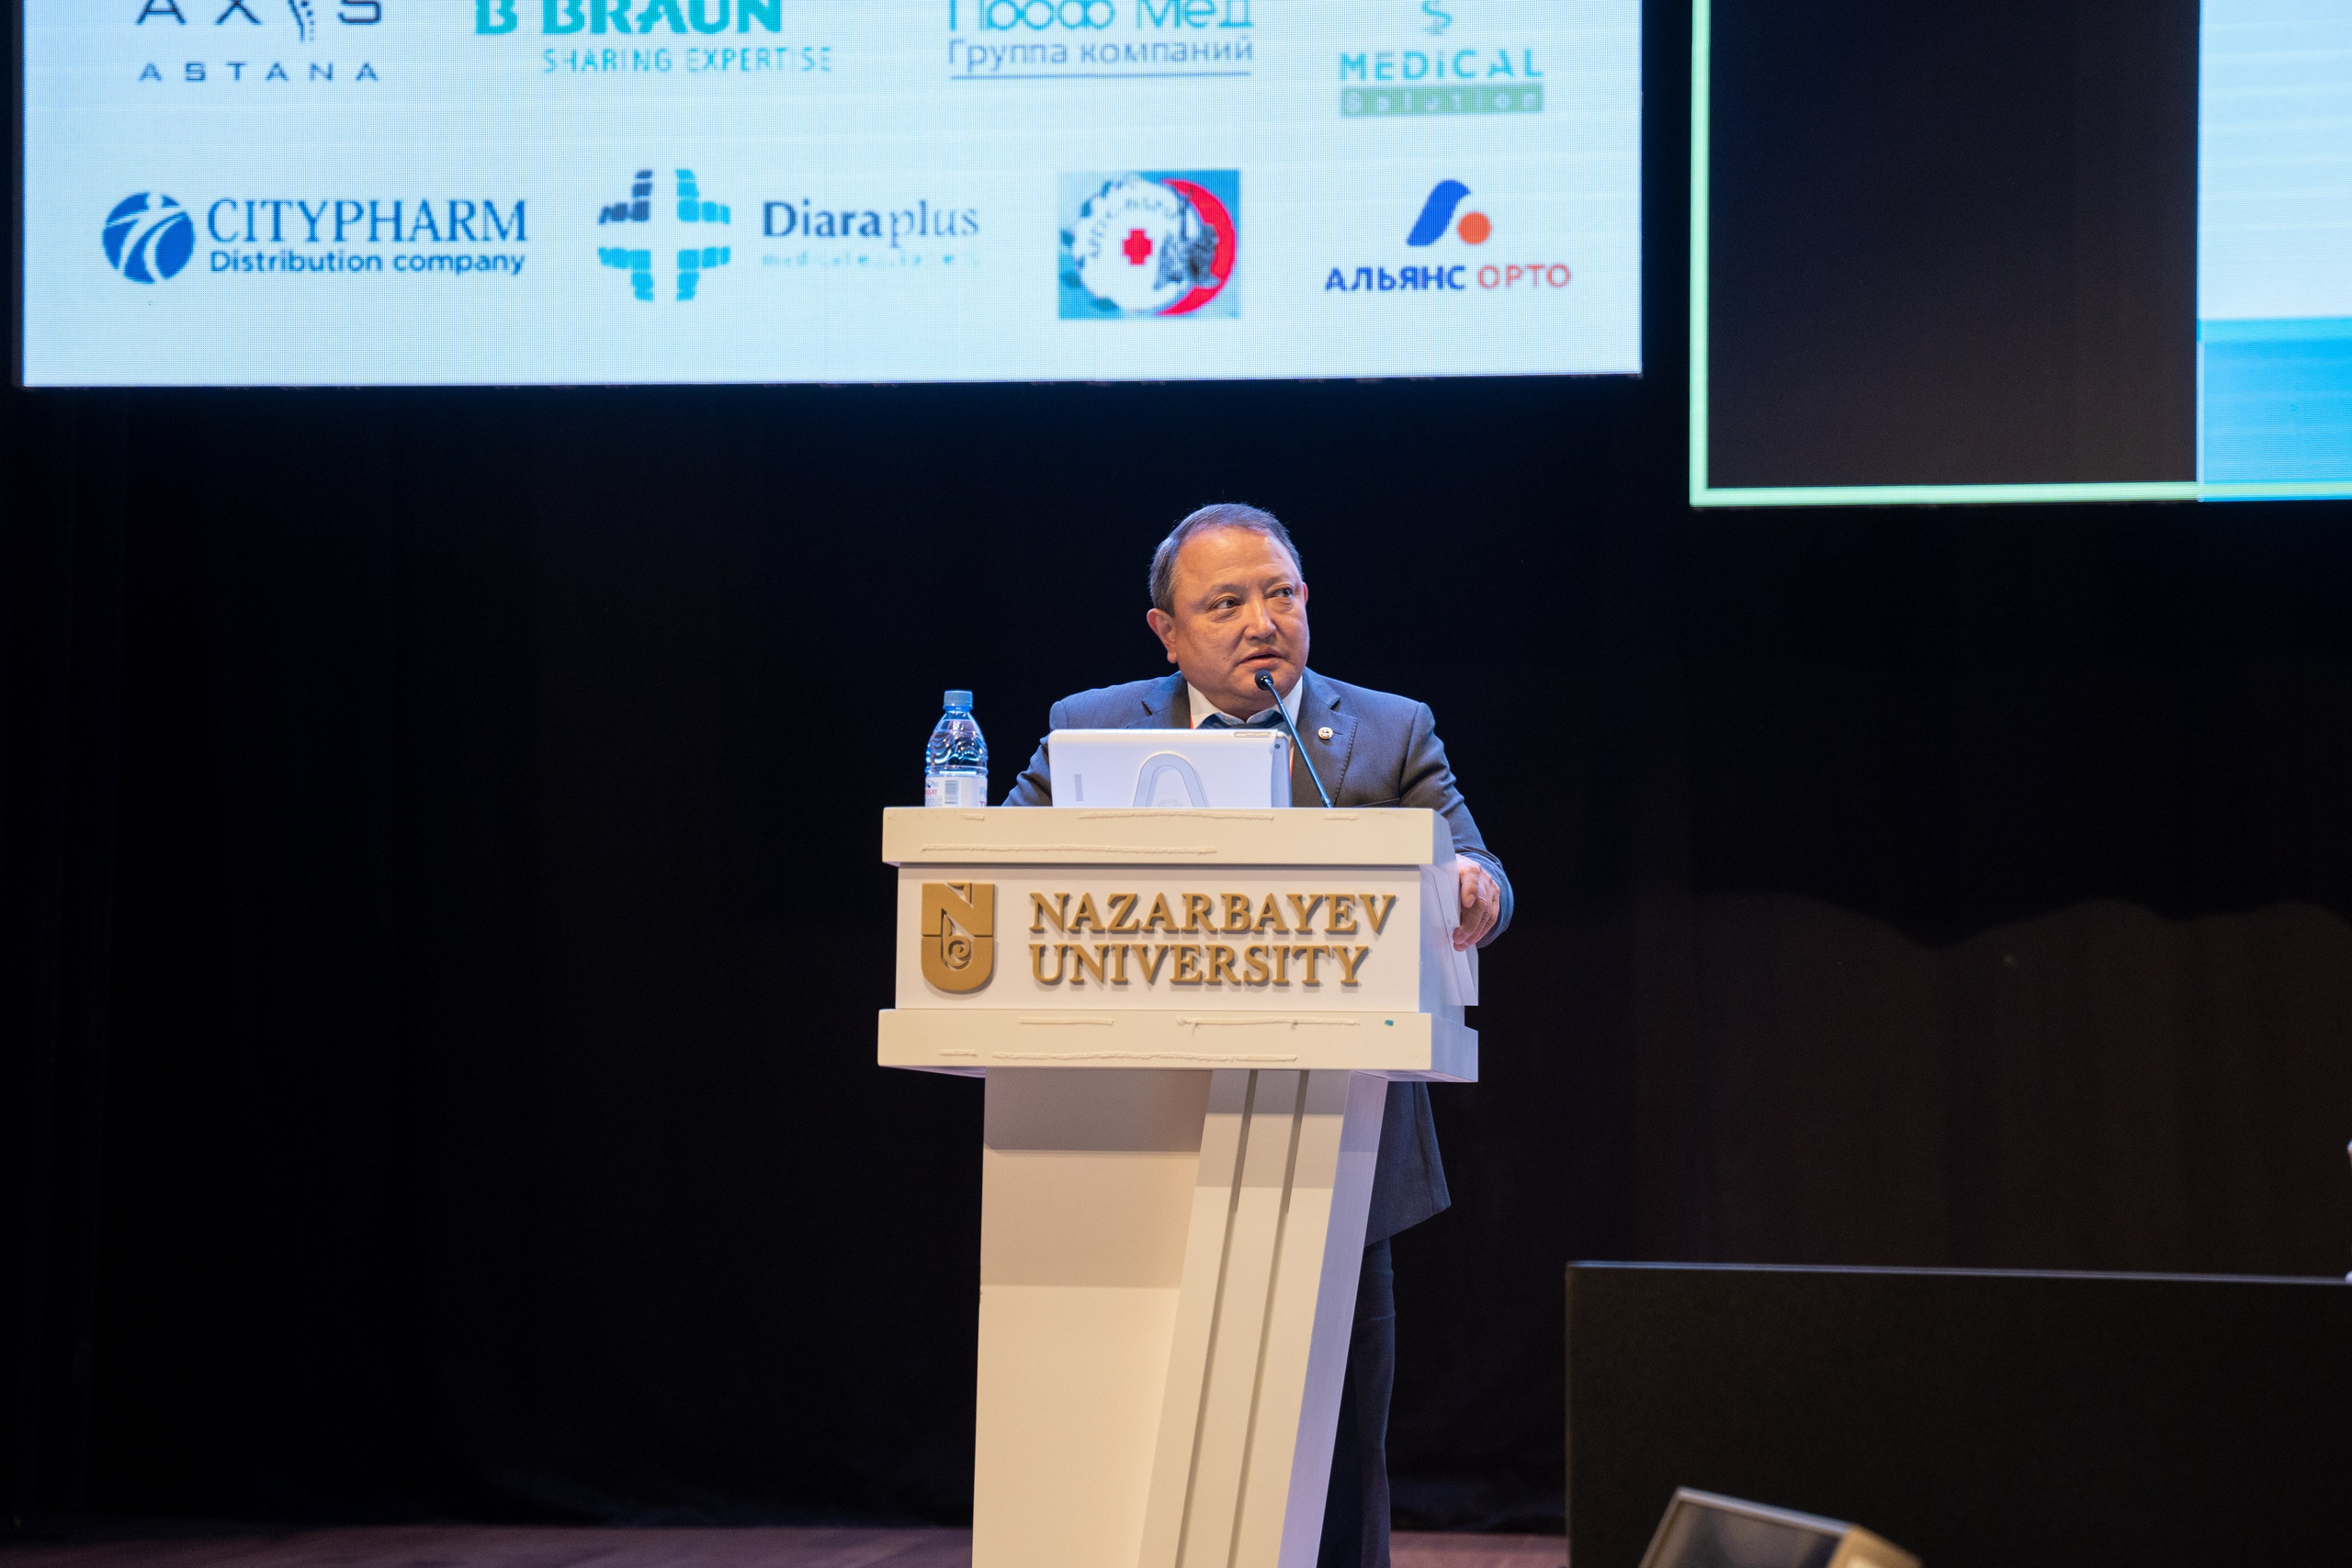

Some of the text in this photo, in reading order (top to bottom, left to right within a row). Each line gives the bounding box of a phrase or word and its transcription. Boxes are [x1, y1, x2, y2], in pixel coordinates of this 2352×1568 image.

[542, 0, 783, 34] BRAUN
[542, 46, 832, 73] SHARING EXPERTISE
[949, 35, 1252, 73] Группа компаний
[139, 61, 379, 82] ASTANA
[207, 197, 528, 243] CITYPHARM
[210, 250, 526, 276] Distribution company
[1325, 264, 1572, 292] АЛЬЯНС ОРТО
[1028, 892, 1396, 934] NAZARBAYEV
[1028, 943, 1370, 986] UNIVERSITY
